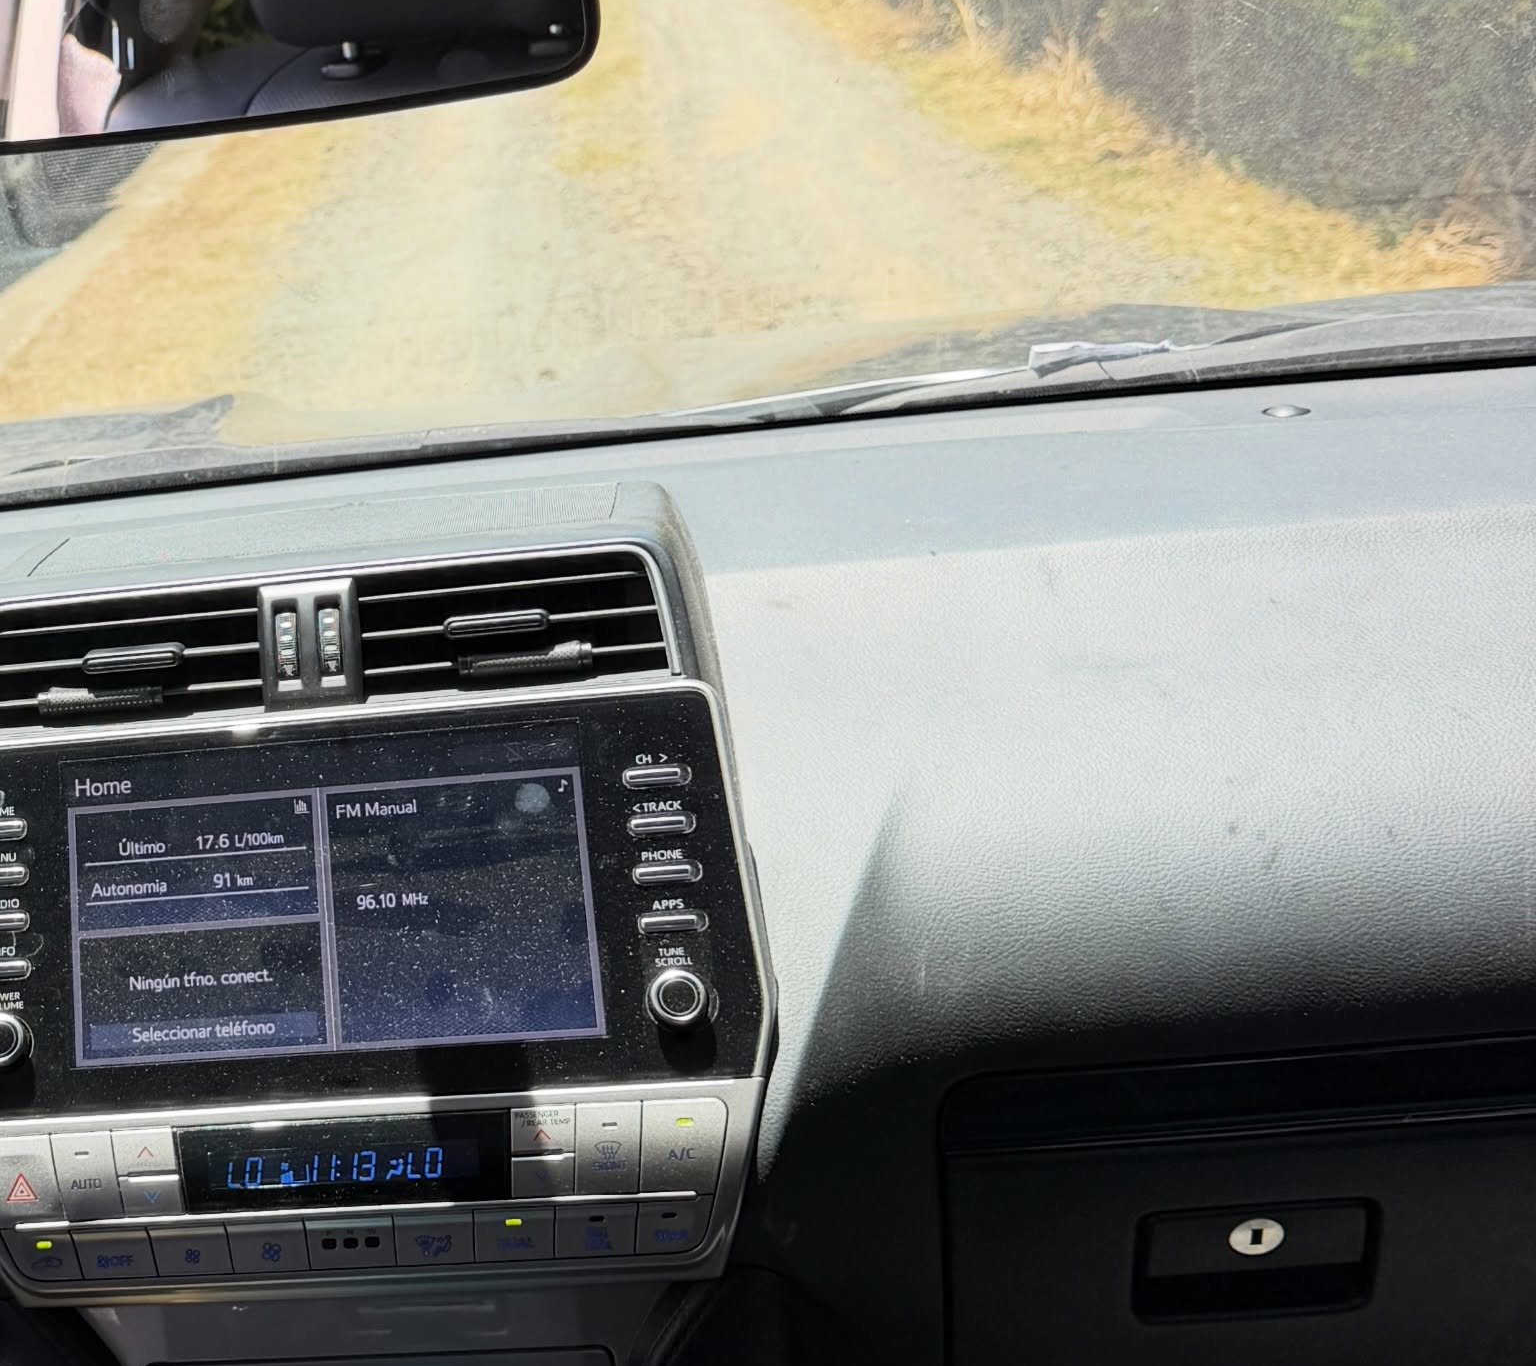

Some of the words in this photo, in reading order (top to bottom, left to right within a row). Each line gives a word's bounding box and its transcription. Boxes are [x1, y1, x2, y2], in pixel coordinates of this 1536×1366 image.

[74, 778, 132, 798] Home
[336, 803, 361, 819] FM
[365, 799, 417, 817] Manual
[119, 837, 166, 857] Último
[195, 834, 230, 850] 17.6
[234, 832, 285, 848] L/100km
[641, 848, 683, 861] PHONE
[213, 873, 231, 888] 91
[237, 874, 254, 887] km
[356, 894, 396, 910] 96.10
[402, 892, 429, 906] MHz
[652, 898, 685, 910] APPS
[658, 946, 686, 957] TUNE
[655, 956, 693, 967] SCROLL
[129, 974, 180, 992] Ningún
[184, 971, 217, 986] tfno.
[221, 968, 273, 984] conect.
[132, 1024, 212, 1043] Seleccionar
[214, 1019, 276, 1038] teléfono
[667, 1147, 696, 1161] A/C
[70, 1177, 102, 1190] AUTO
